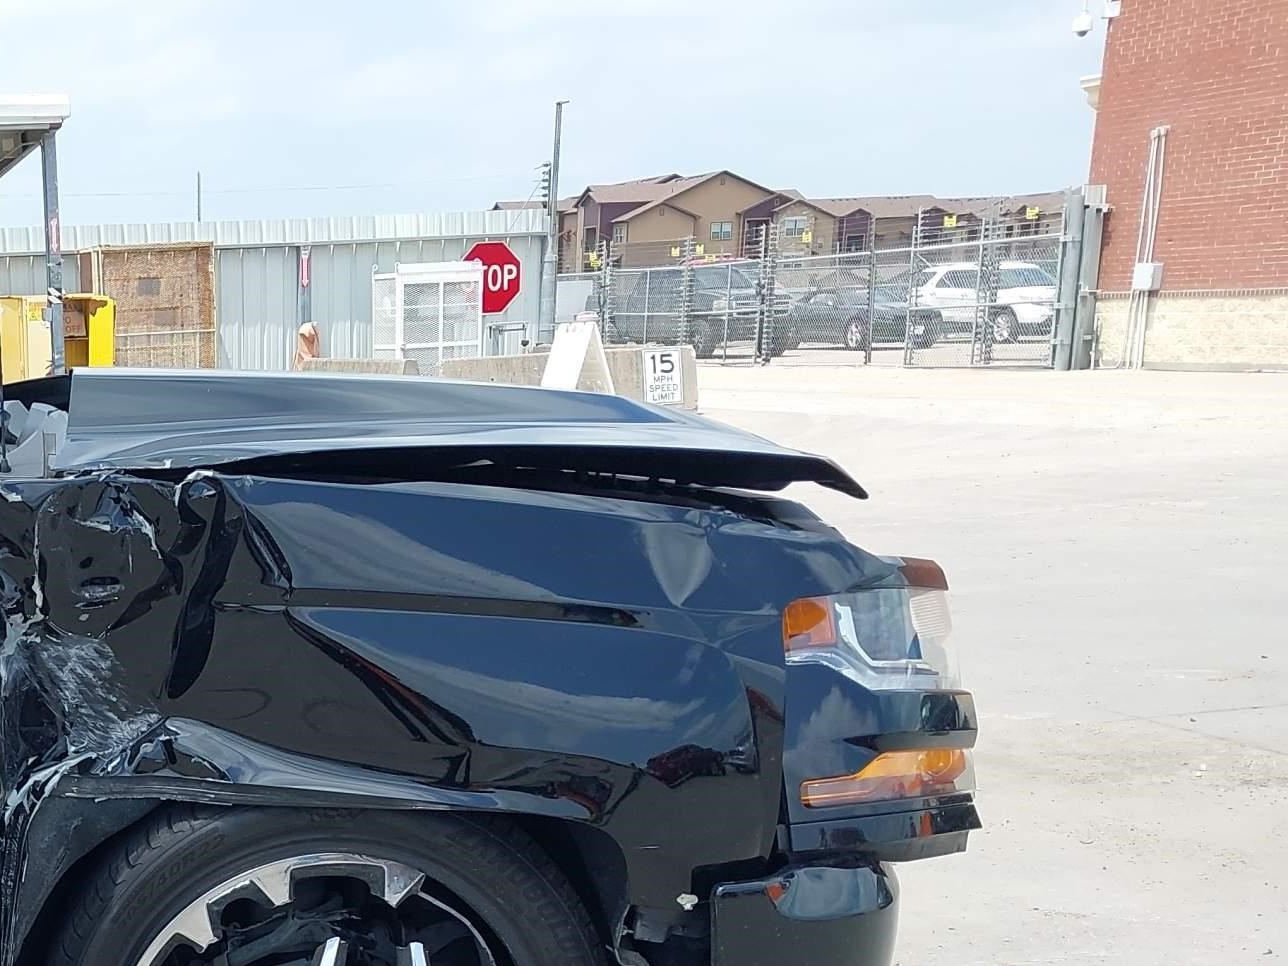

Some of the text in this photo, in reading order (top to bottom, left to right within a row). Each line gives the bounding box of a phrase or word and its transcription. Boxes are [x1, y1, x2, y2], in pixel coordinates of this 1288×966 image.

[482, 264, 517, 292] OP
[650, 353, 675, 374] 15
[653, 375, 673, 384] MPH
[649, 383, 679, 393] SPEED
[652, 392, 676, 401] LIMIT
